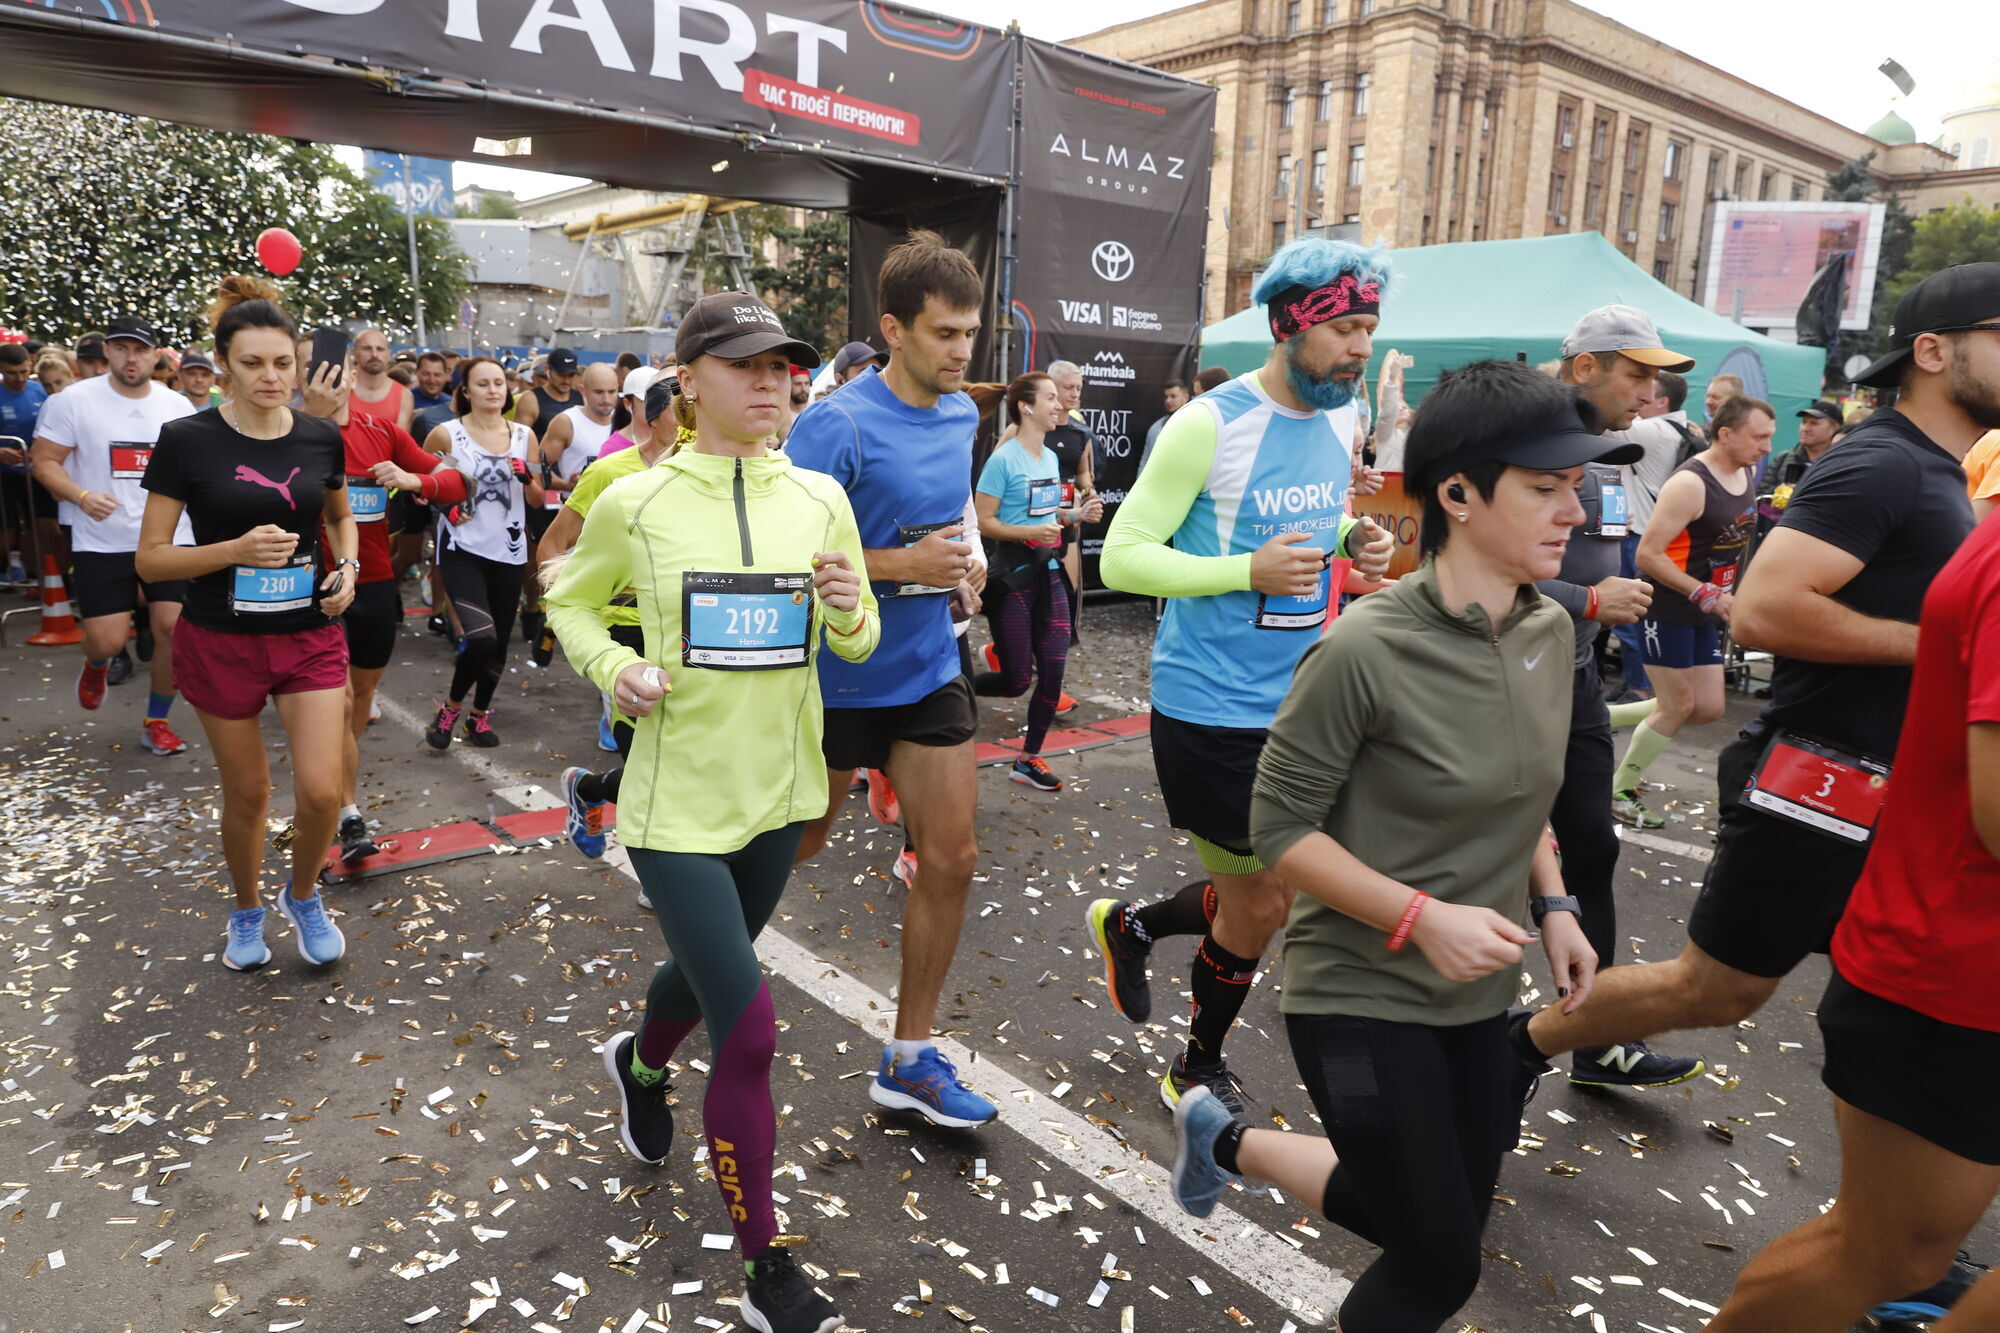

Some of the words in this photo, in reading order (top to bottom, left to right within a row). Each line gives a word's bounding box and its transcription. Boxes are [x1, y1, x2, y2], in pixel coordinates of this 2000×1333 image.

[283, 0, 847, 94] ART
[759, 82, 787, 107] ЧАС
[790, 91, 831, 117] ТВОЄЇ
[833, 103, 905, 136] ПЕРЕМОГИ!
[1050, 133, 1185, 180] ALMAZ
[1086, 175, 1149, 194] GROUP
[732, 306, 752, 315] Do
[734, 315, 757, 325] like
[1058, 299, 1102, 325] VISA
[1128, 308, 1158, 322] беремо
[1132, 320, 1162, 331] робимо
[1080, 363, 1136, 380] shambala
[350, 493, 378, 508] 2190
[1252, 524, 1274, 536] ТИ
[1278, 517, 1336, 536] ЗМОЖЕШ
[259, 576, 295, 594] 2301
[725, 607, 778, 634] 2192
[1815, 773, 1836, 797] 3
